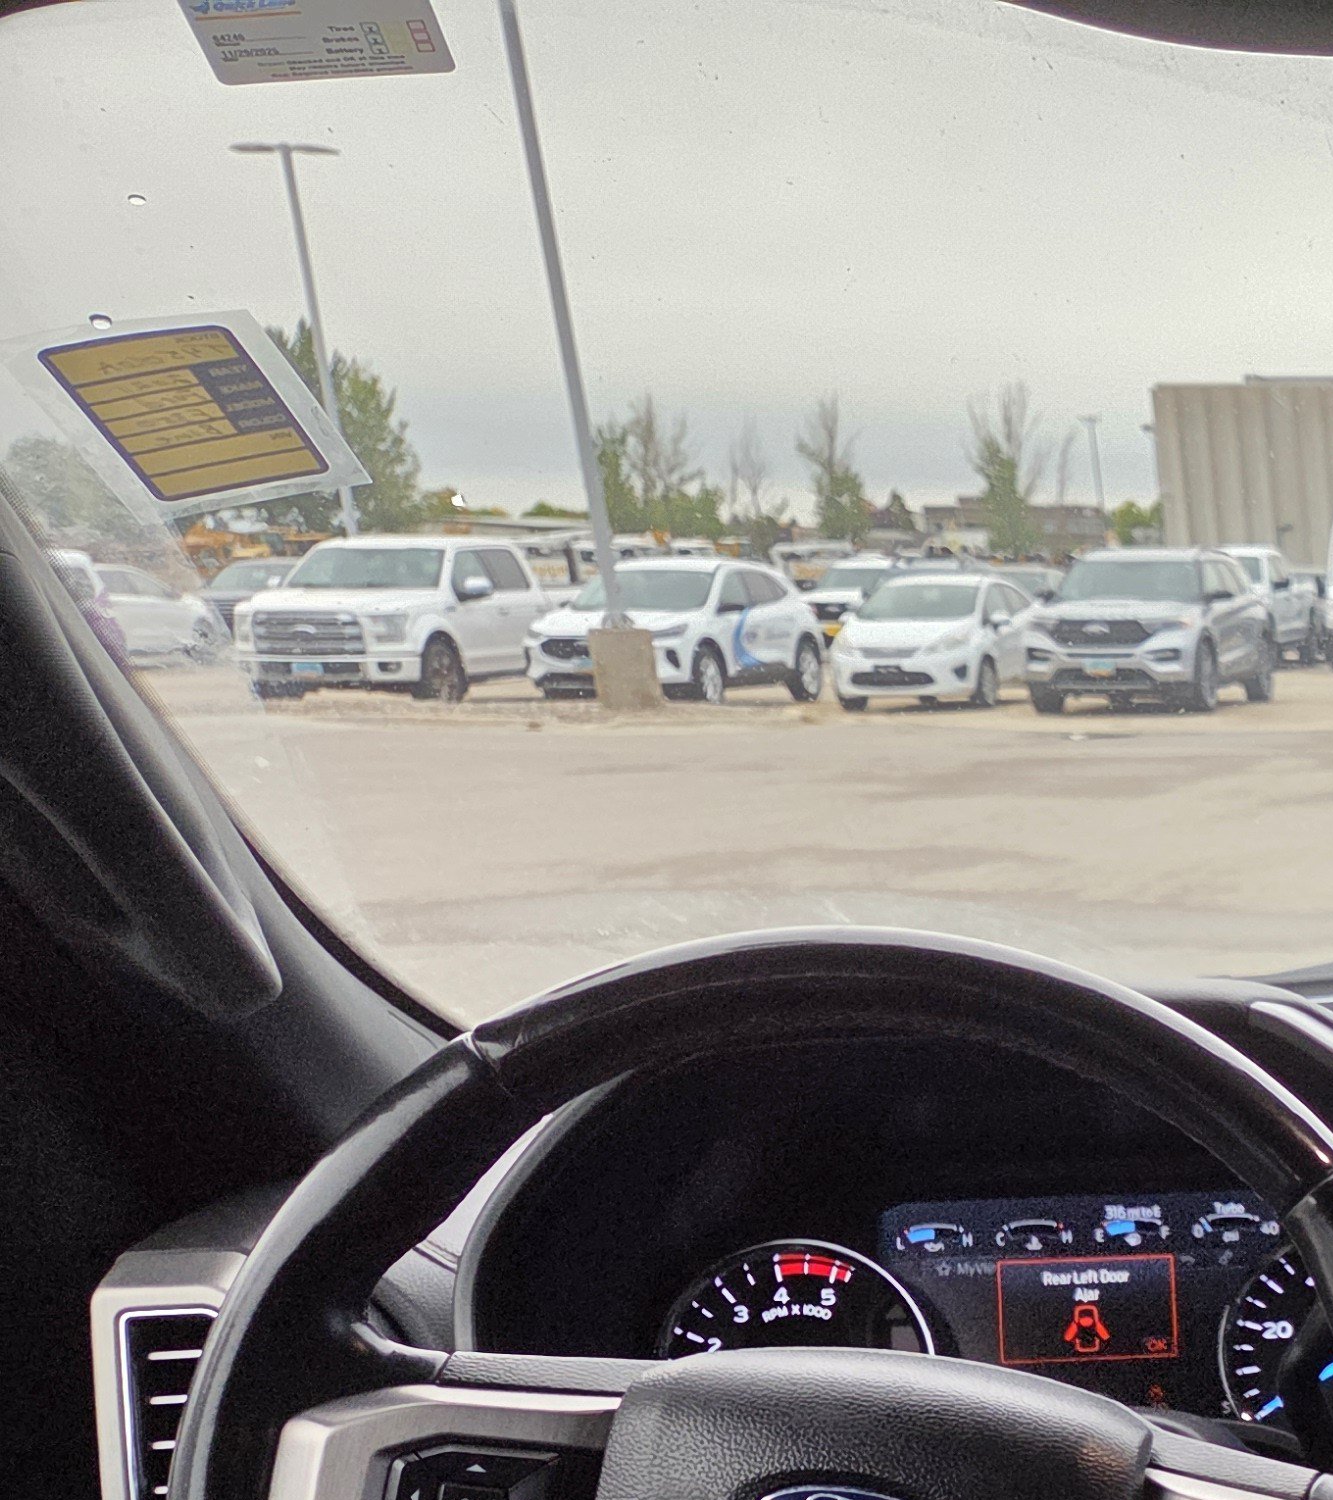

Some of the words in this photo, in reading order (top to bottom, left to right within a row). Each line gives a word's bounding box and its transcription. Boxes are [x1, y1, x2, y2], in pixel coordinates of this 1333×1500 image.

[1104, 1204, 1126, 1220] 316
[1042, 1270, 1072, 1286] Rear
[1072, 1269, 1099, 1285] Left
[1100, 1268, 1130, 1284] Door
[773, 1287, 790, 1304] 4
[820, 1288, 836, 1306] 5
[1074, 1287, 1100, 1303] Ajar
[733, 1305, 749, 1323] 3
[761, 1306, 788, 1323] RPM
[802, 1304, 832, 1320] 1000
[1262, 1320, 1294, 1340] 20
